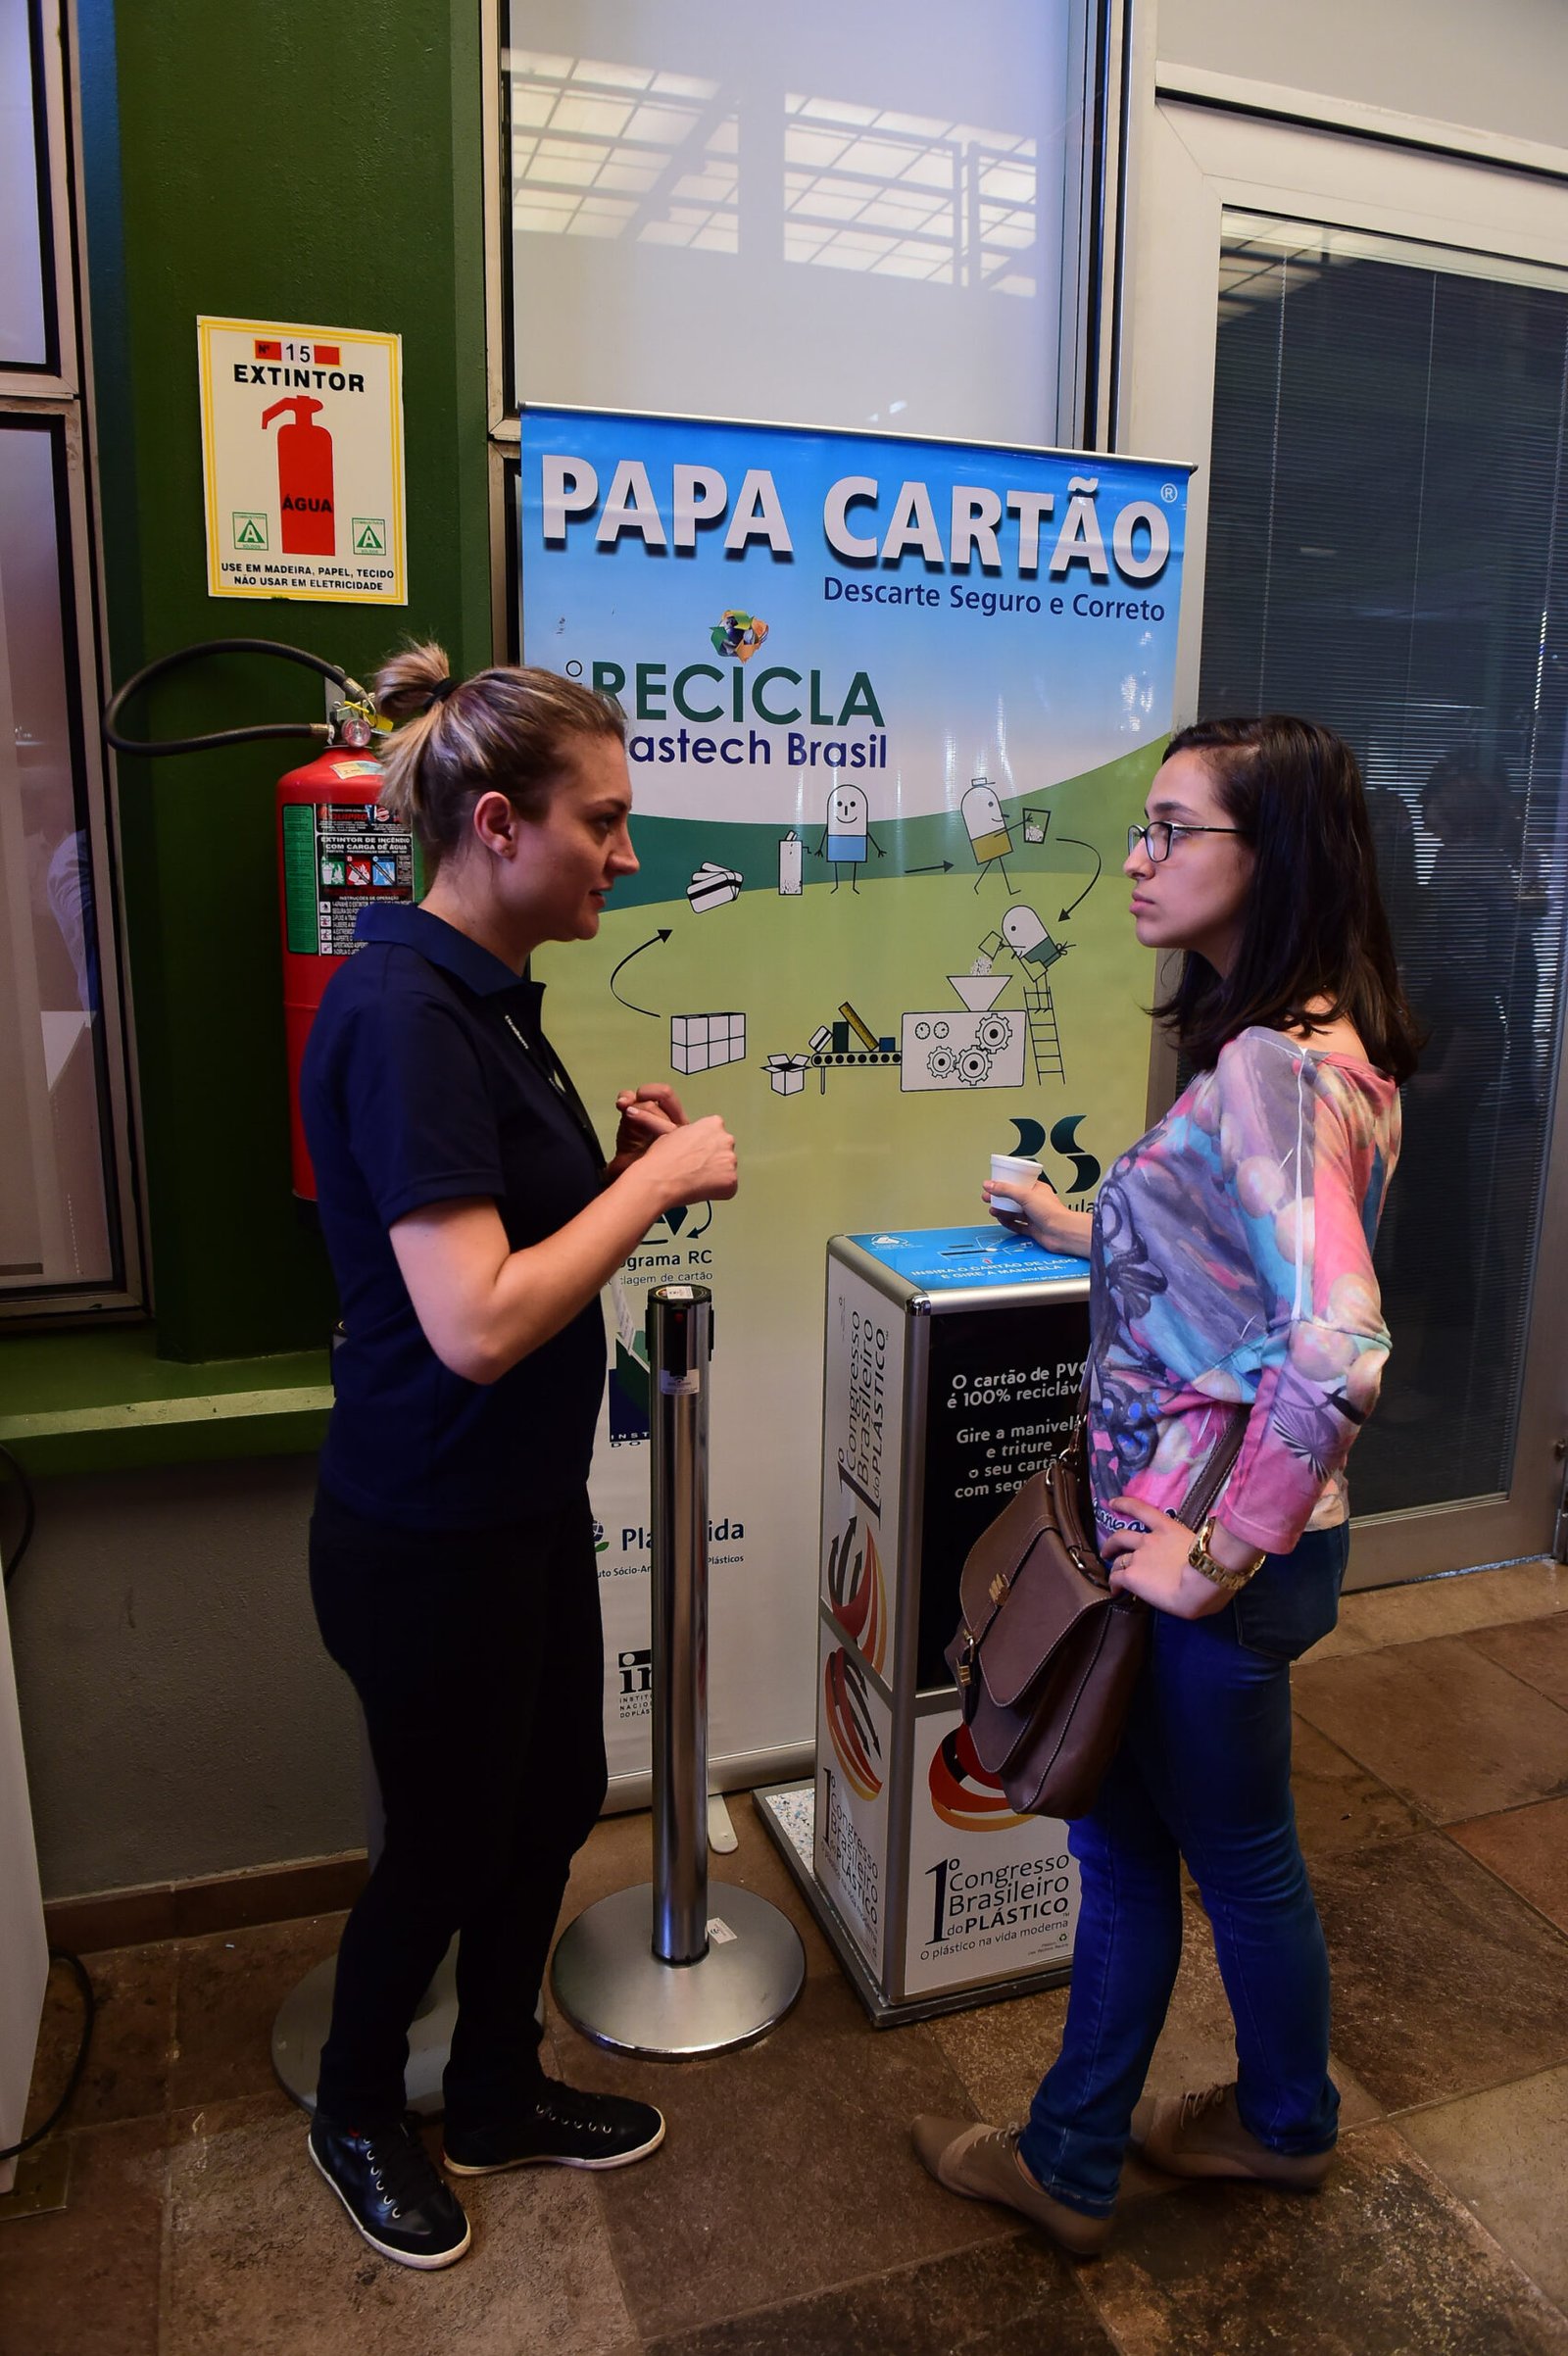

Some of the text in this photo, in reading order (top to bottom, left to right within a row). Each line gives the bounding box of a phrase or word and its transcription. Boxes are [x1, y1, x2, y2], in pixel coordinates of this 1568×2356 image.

[285, 343, 311, 363] 15
[233, 364, 365, 393] EXTINTOR
[281, 494, 332, 513] ÁGUA
[541, 454, 793, 553] PAPA
[823, 476, 1170, 579] CARTÃO
[221, 563, 394, 579] USE EM MADEIRA, PAPEL, TECIDO
[234, 574, 383, 591] NÃO USAR EM ELETRICIDADE
[824, 576, 1164, 623] Descarte Seguro e Correto
[592, 661, 885, 728] RECICLA
[629, 728, 887, 769] astech Brasil
[620, 1251, 712, 1271] grama RC
[661, 1273, 674, 1283] de
[678, 1272, 712, 1282] cartão
[847, 1310, 860, 1471] Congresso
[948, 1381, 1082, 1408] é 100% recicláv
[953, 1374, 966, 1389] O
[974, 1369, 1026, 1388] cartão
[1031, 1367, 1050, 1381] de
[858, 1319, 873, 1486] Brasileiro
[870, 1328, 886, 1476] PLÁSTICO
[956, 1428, 990, 1444] Gire
[996, 1429, 1005, 1440] a
[986, 1441, 1053, 1458] e triture
[968, 1454, 1067, 1479] o seu cartã
[955, 1484, 989, 1498] com
[831, 1792, 878, 1880] Congresso
[831, 1812, 878, 1904] Brasileiro
[950, 1854, 1069, 1891] Congresso
[949, 1876, 1069, 1916] Brasileiro
[947, 1923, 962, 1937] do
[964, 1897, 1068, 1934] PLÁSTICO
[920, 1920, 1068, 1960] O plástico na vida moderna
